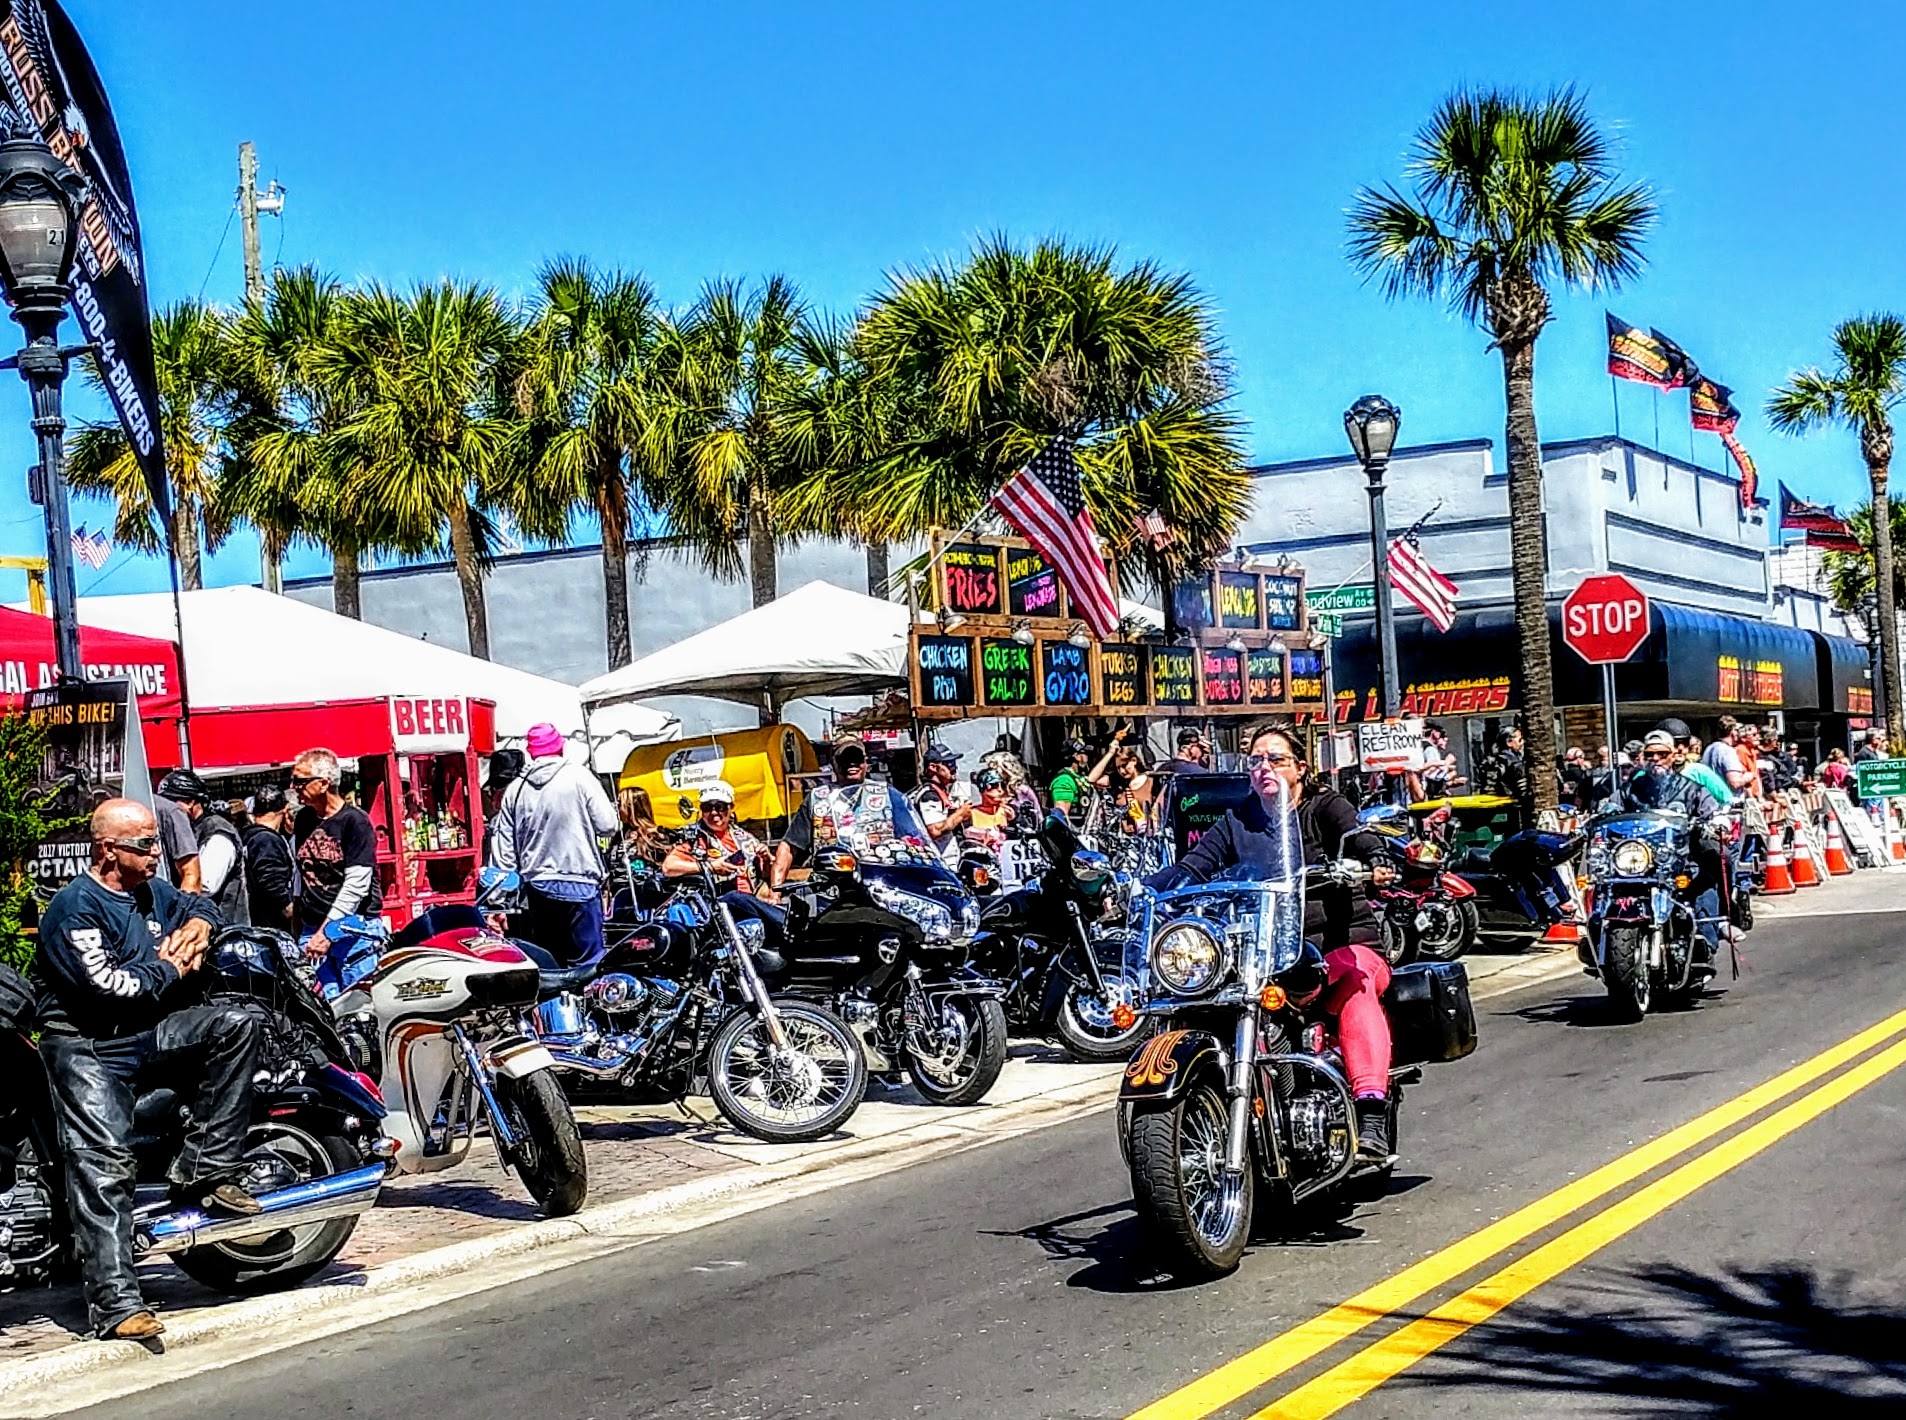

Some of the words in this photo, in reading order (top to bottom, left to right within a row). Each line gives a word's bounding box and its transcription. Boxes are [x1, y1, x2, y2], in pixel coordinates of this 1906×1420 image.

[0, 17, 57, 128] RUSS
[49, 229, 65, 246] 21
[67, 262, 155, 457] 1-800-4-BIKERS
[1568, 599, 1643, 638] STOP
[919, 643, 968, 671] CHICKEN
[984, 647, 1030, 672] GREEK
[1051, 647, 1081, 667] LAMB
[1101, 652, 1139, 676] TURKEY
[1153, 654, 1193, 680] CHICKEN
[0, 661, 31, 694] AL
[989, 677, 1027, 701] SALAD
[1045, 671, 1089, 703] GYRO
[1109, 679, 1135, 702] LEGS
[78, 702, 115, 724] BIKE!
[1363, 685, 1510, 721] LATHERS
[394, 699, 465, 735] BEER
[1360, 722, 1408, 736] CLEAN
[1860, 761, 1906, 771] MOTORCYCLE
[1867, 773, 1900, 781] PARKING
[38, 844, 56, 858] 2017
[58, 842, 92, 857] VICTORY
